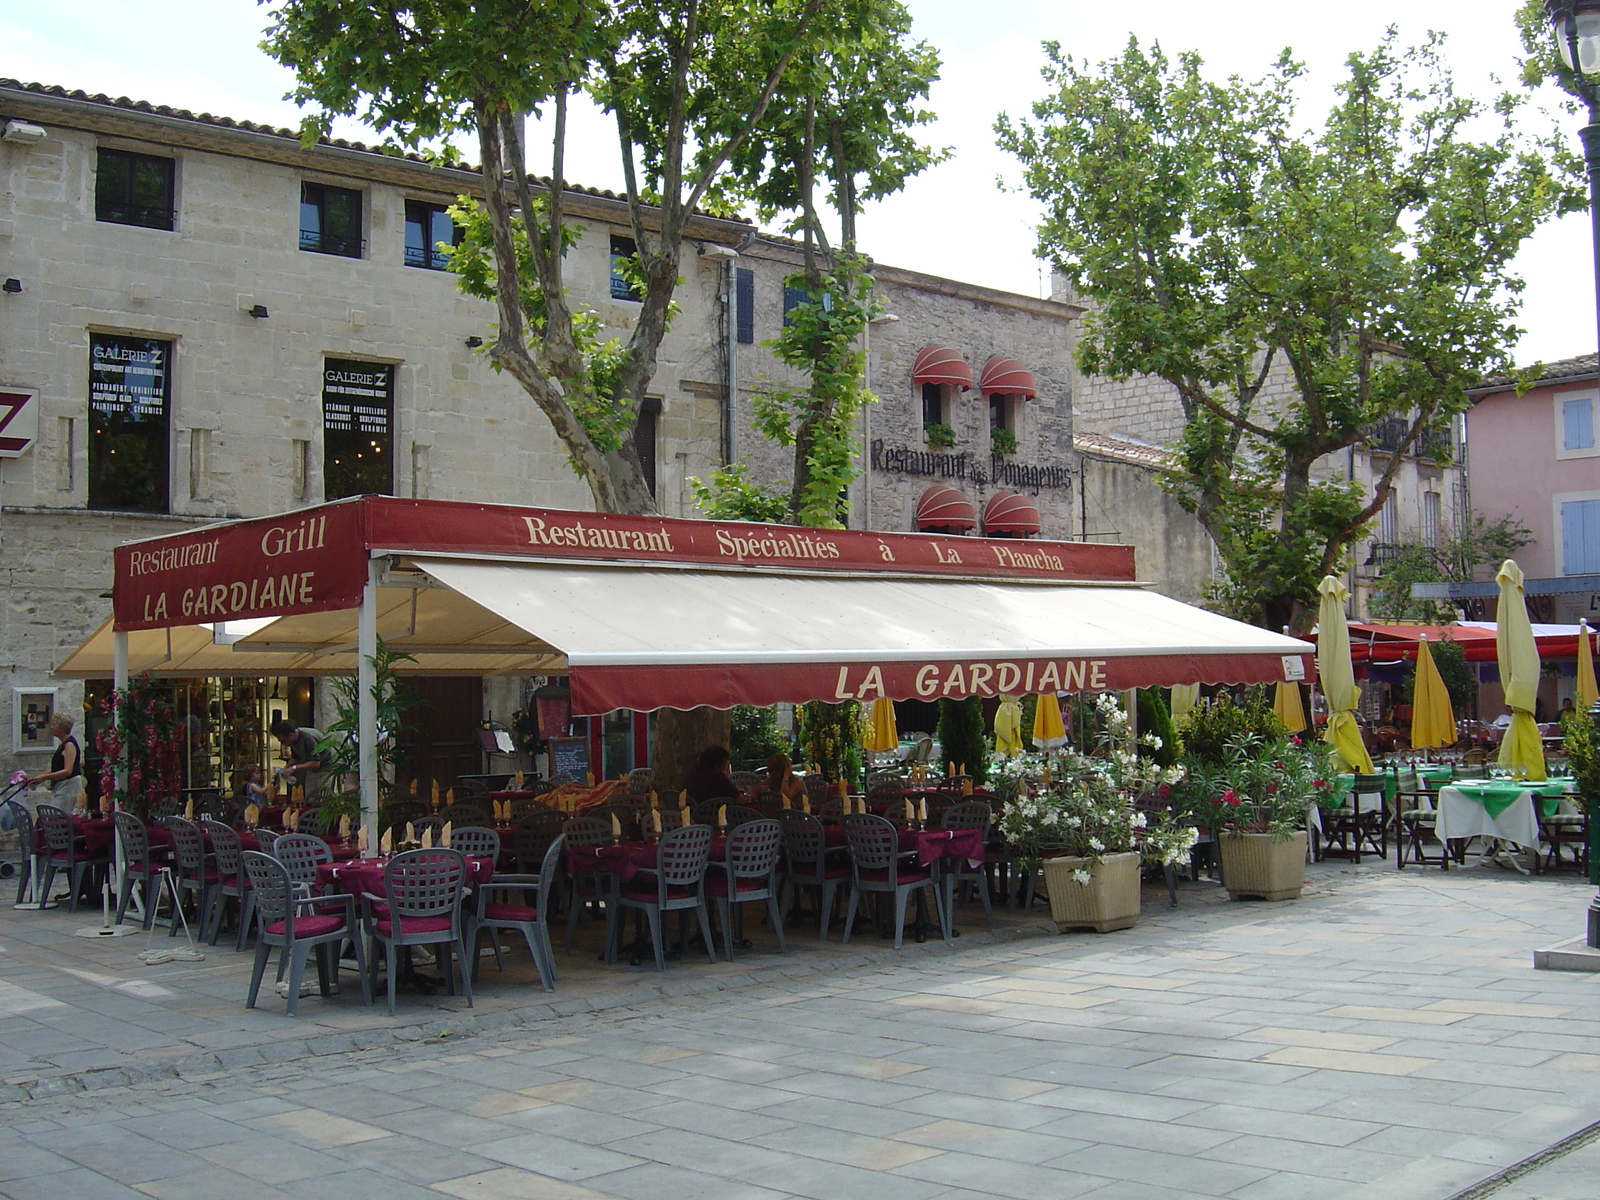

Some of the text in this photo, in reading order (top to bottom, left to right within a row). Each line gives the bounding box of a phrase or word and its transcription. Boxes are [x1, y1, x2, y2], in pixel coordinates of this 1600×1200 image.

[93, 346, 162, 363] GALERIE Z
[325, 370, 386, 385] GALERIE Z
[92, 382, 162, 395] PERMANENT EXHIBITION
[92, 402, 124, 411] PAINTINGS
[133, 405, 162, 414] CERAMICS
[353, 405, 386, 415] AUSSTELLUNG
[325, 421, 350, 430] MALEREI
[360, 424, 386, 433] KERAMIK
[870, 438, 1071, 496] Restaurant des Voyageurs
[129, 515, 326, 577] Restaurant Grill
[521, 516, 1064, 571] Restaurant Spécialités à La Plancha
[144, 571, 315, 622] LA GARDIANE
[835, 660, 1107, 699] LA GARDIANE
